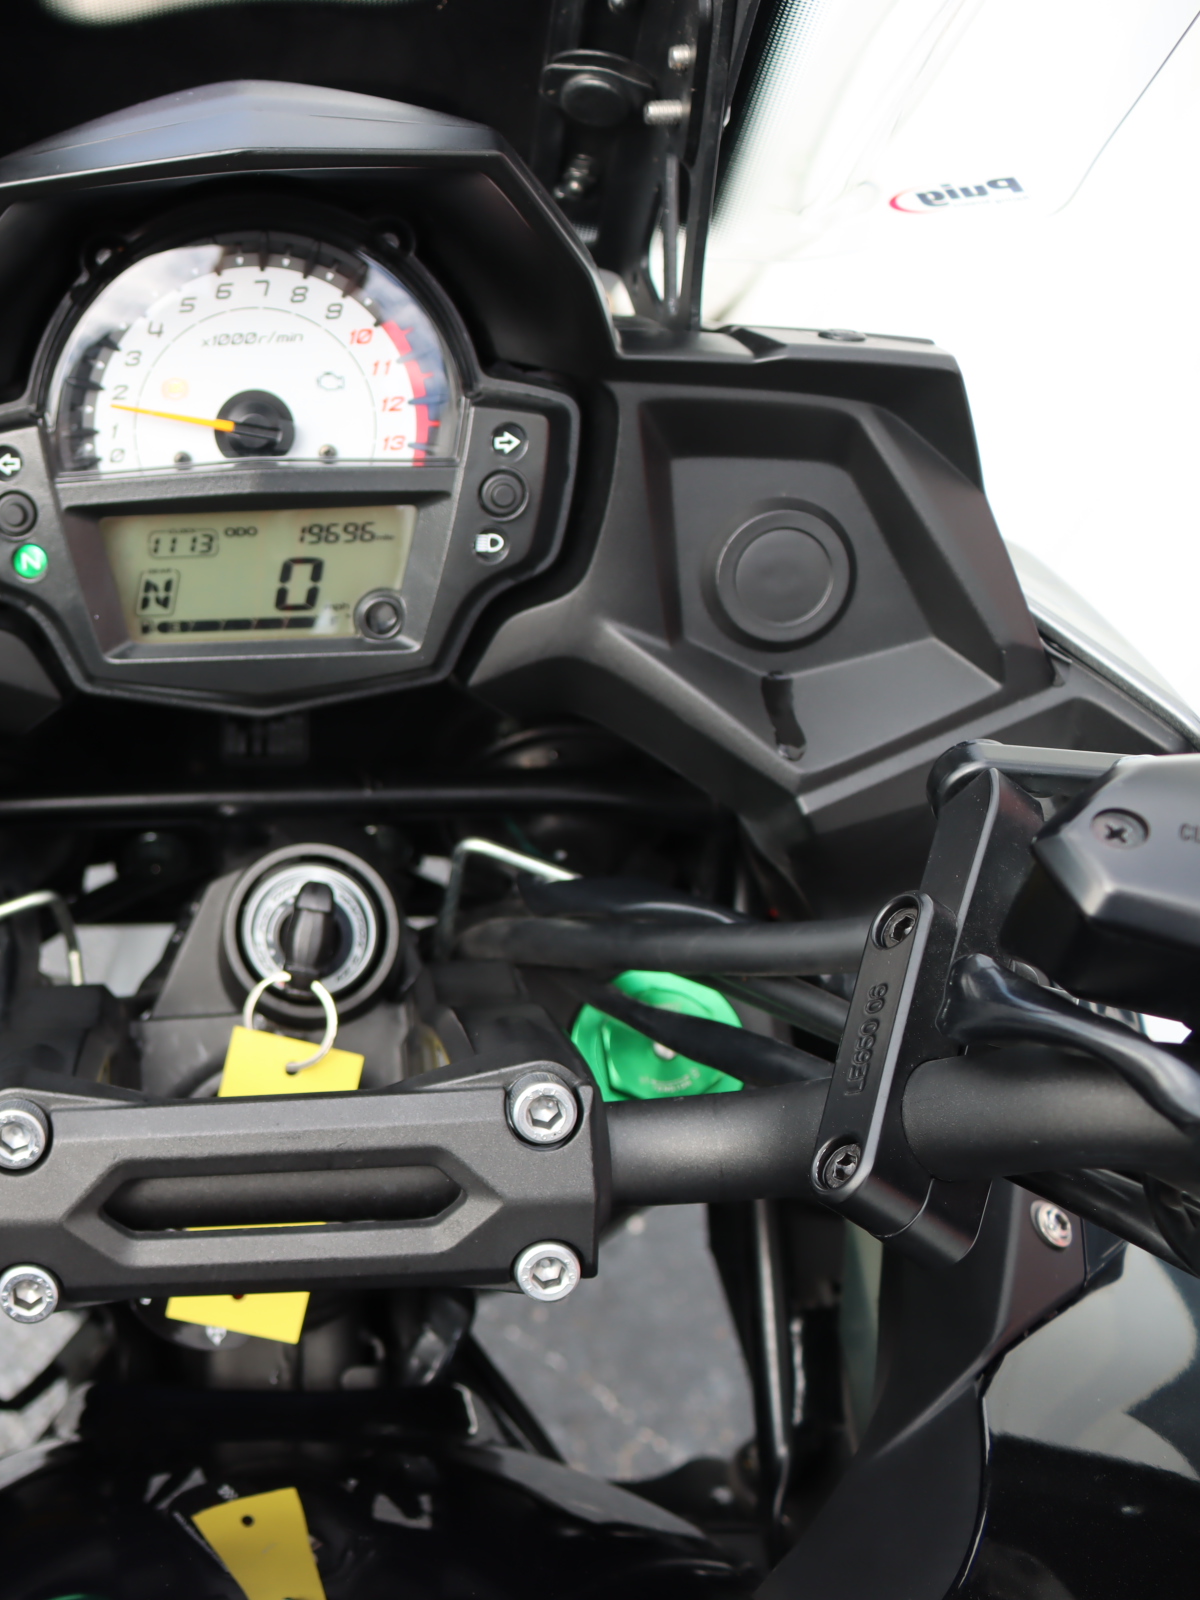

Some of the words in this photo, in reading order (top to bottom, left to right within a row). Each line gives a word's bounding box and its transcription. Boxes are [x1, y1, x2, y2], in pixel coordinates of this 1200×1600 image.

[215, 283, 235, 299] 6
[254, 280, 271, 297] 7
[290, 286, 309, 304] 8
[179, 297, 197, 314] 5
[325, 303, 345, 320] 9
[147, 321, 164, 338] 4
[349, 328, 374, 345] 10
[124, 351, 142, 366] 3
[371, 360, 393, 376] 11
[112, 385, 130, 400] 2
[381, 396, 406, 413] 12
[381, 435, 406, 451] 13
[300, 521, 377, 544] 19696
[20, 551, 43, 571] N
[275, 557, 324, 611] 0
[141, 578, 173, 611] N
